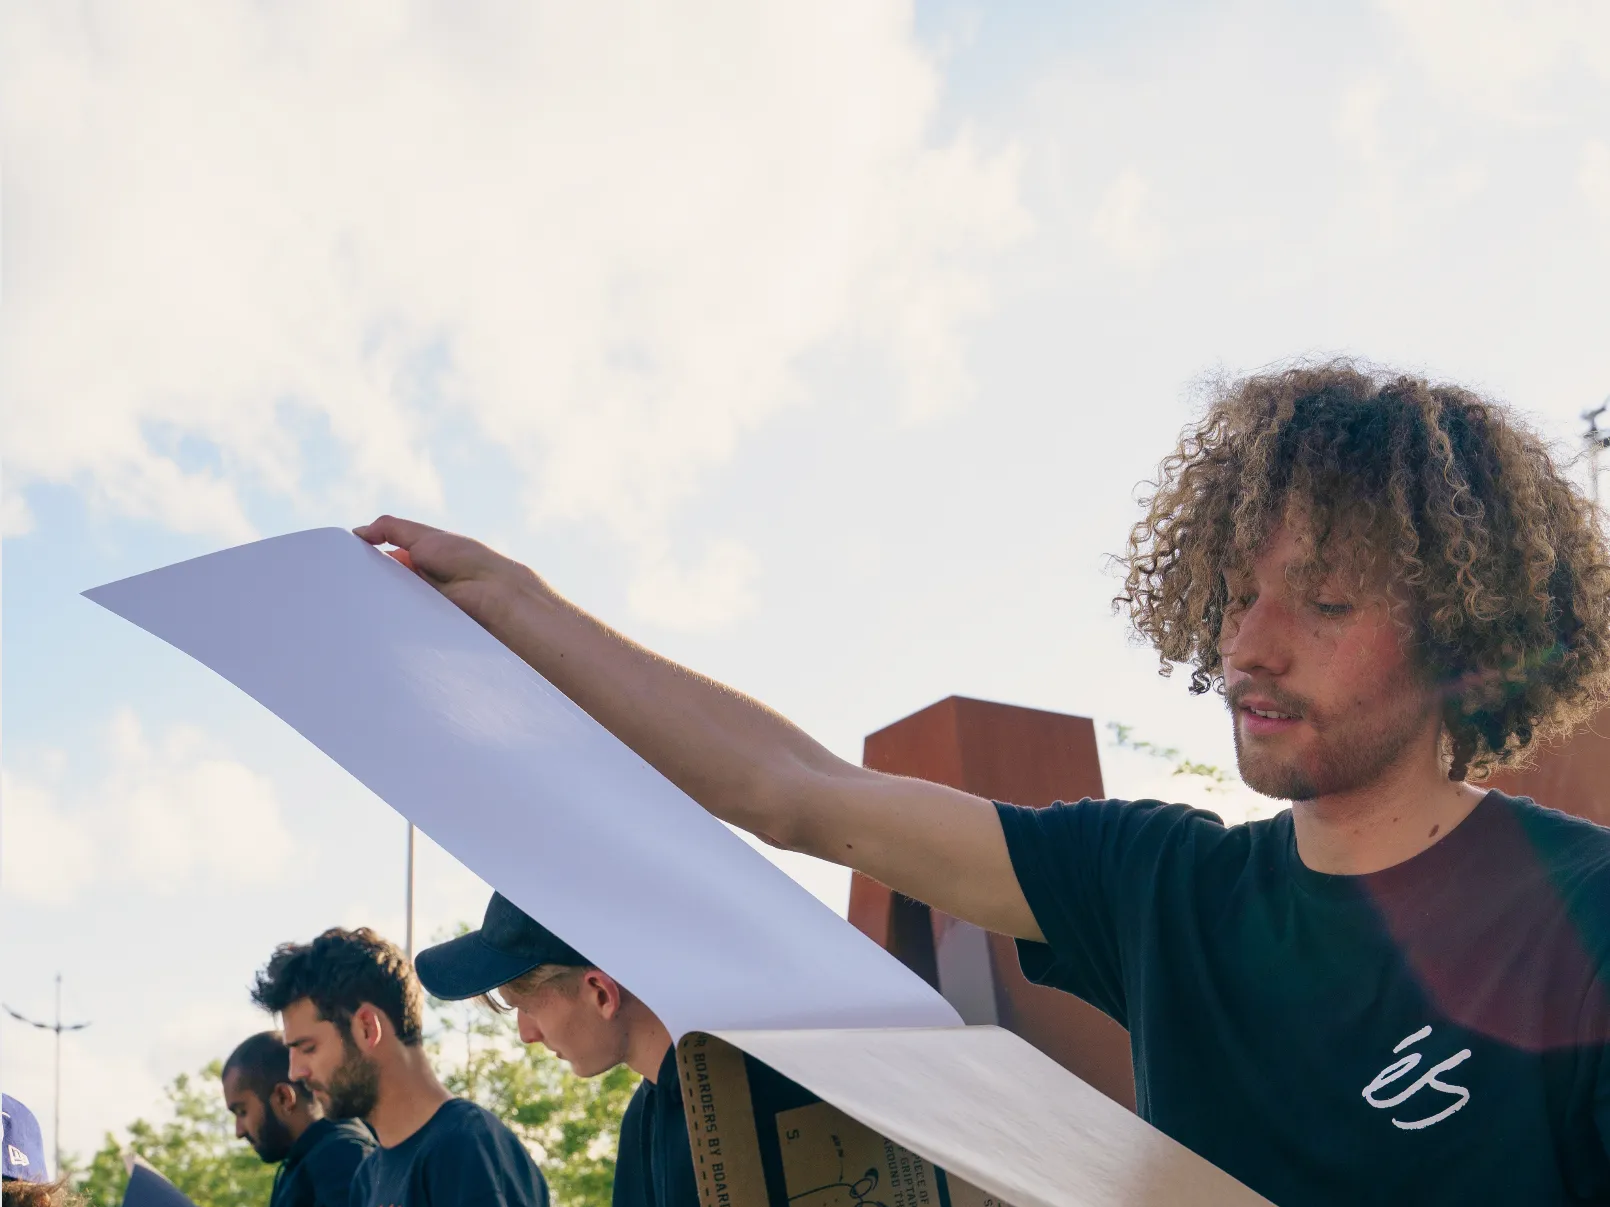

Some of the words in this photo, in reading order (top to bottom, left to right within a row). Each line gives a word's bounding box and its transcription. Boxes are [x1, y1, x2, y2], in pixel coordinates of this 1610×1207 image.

[693, 1053, 718, 1133] BOARDERS
[708, 1137, 722, 1157] BY
[919, 1190, 930, 1205] OF
